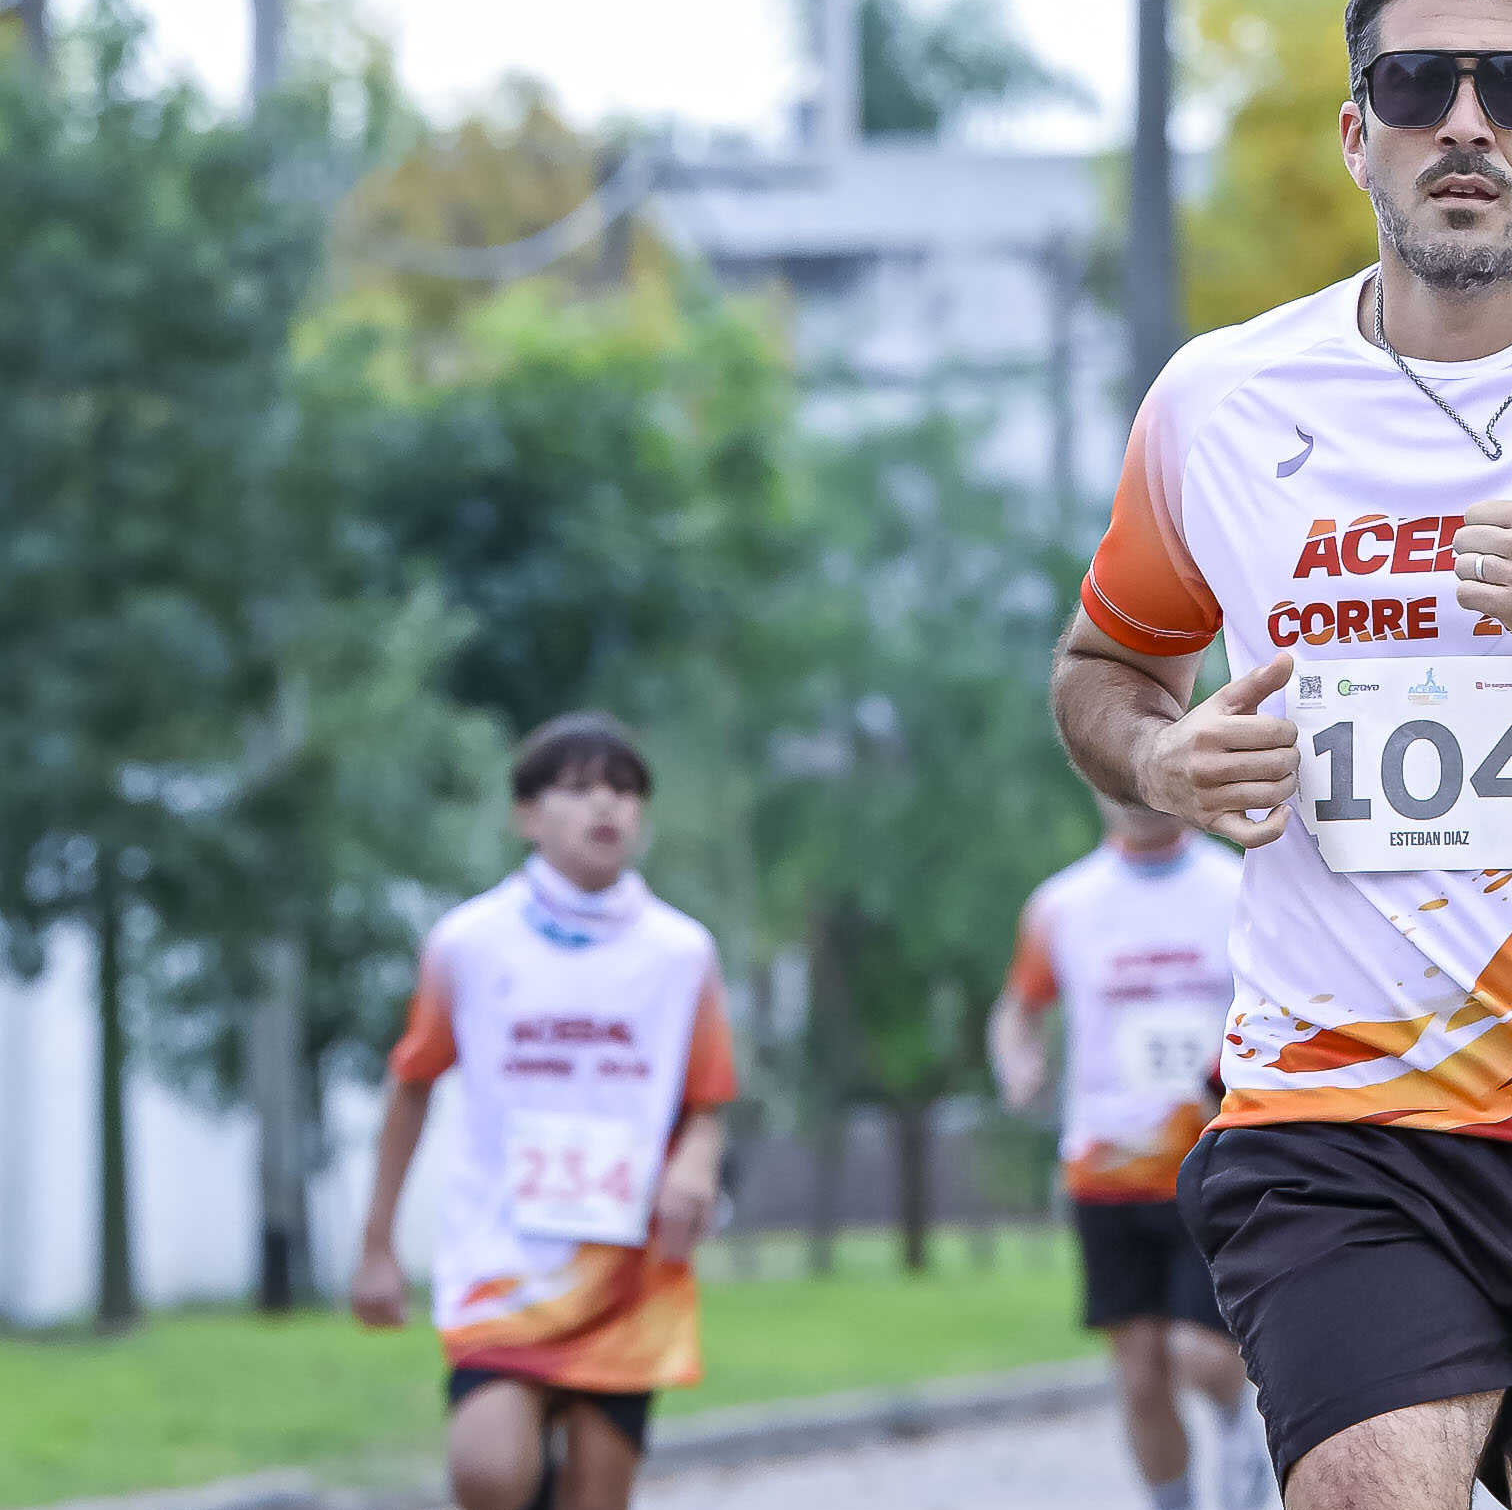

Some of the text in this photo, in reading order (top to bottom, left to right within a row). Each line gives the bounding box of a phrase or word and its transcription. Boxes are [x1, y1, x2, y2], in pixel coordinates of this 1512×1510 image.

[1293, 514, 1466, 579] ACE
[1268, 597, 1439, 647] CORRE
[1390, 831, 1470, 847] ESTEBAN DIAZ
